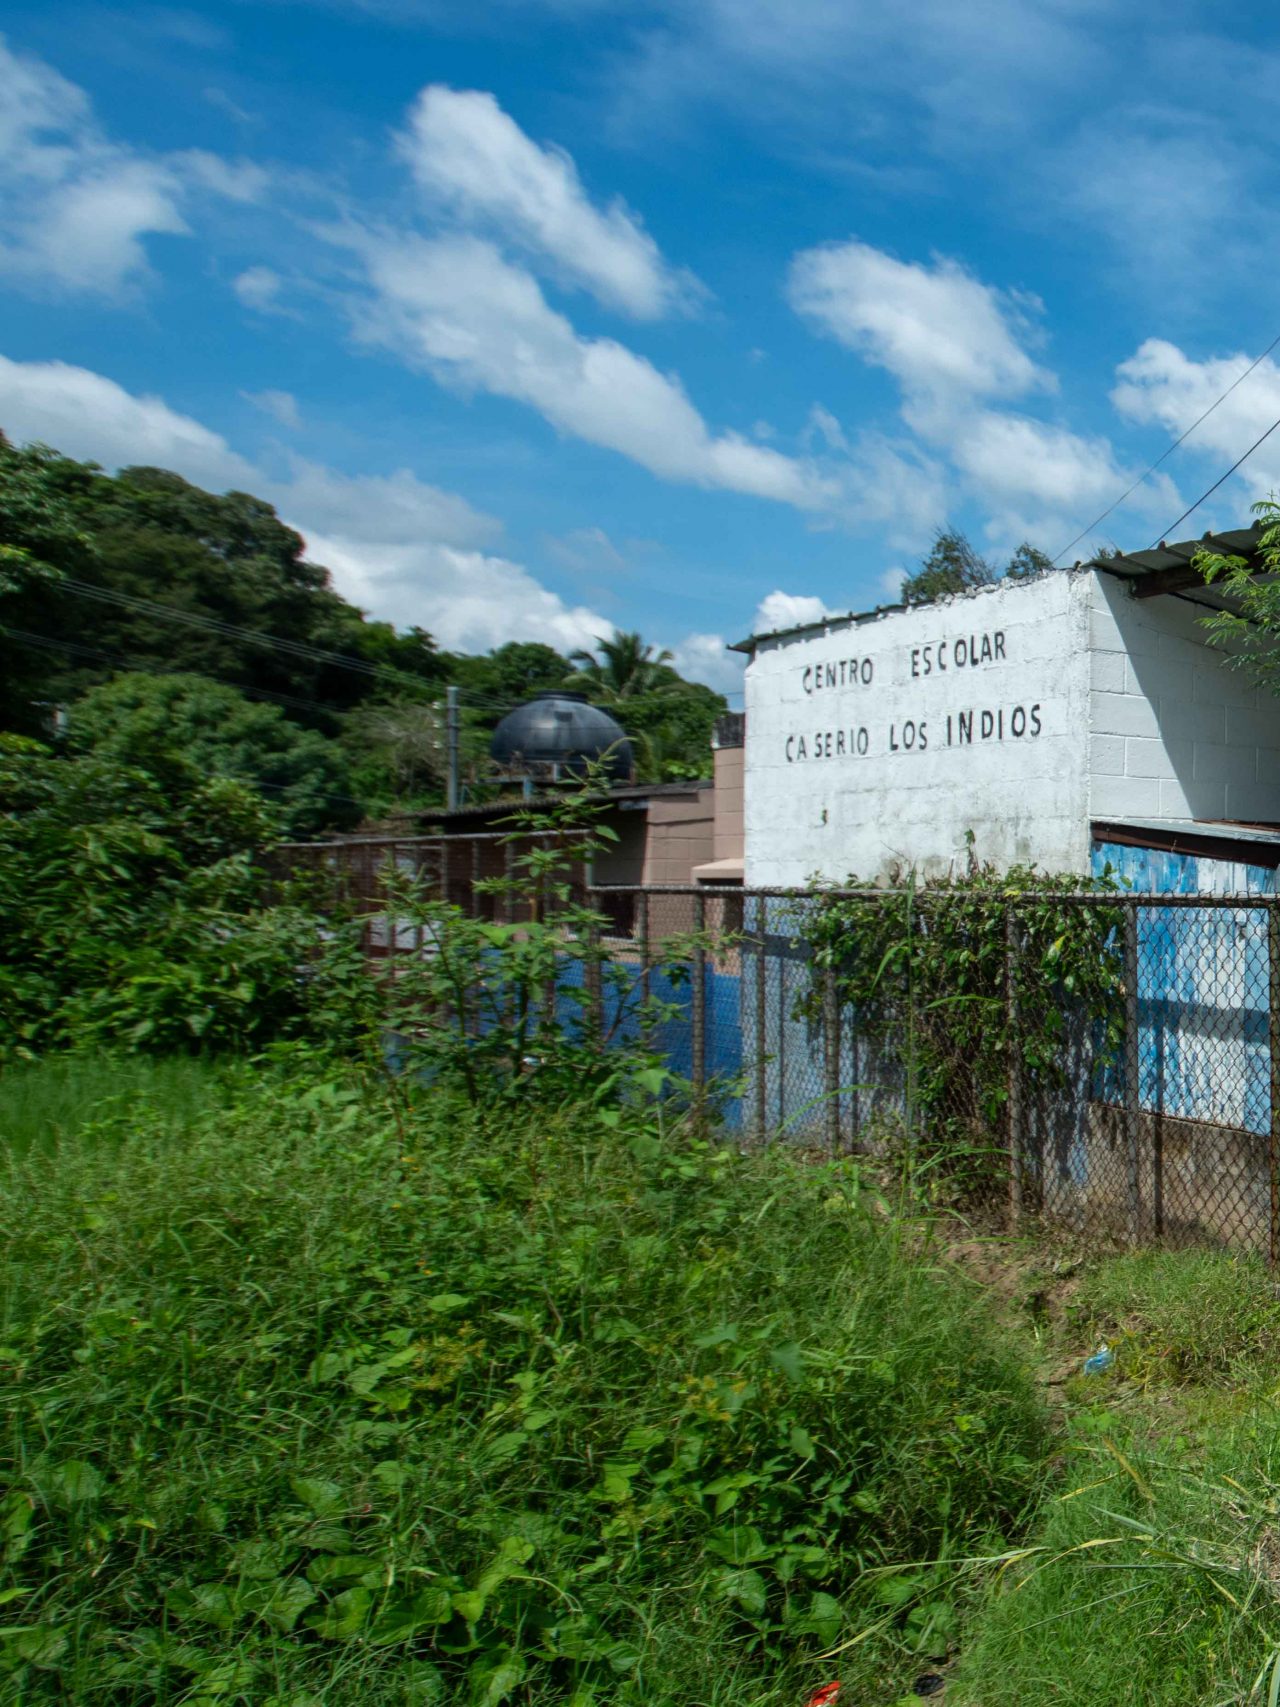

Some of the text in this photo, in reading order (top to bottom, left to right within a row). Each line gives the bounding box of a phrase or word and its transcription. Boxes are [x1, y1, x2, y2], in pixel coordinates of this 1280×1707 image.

[802, 631, 1007, 694] CENTRO ESCOLAR
[785, 704, 1042, 763] CASERIO LOS INDIOS
